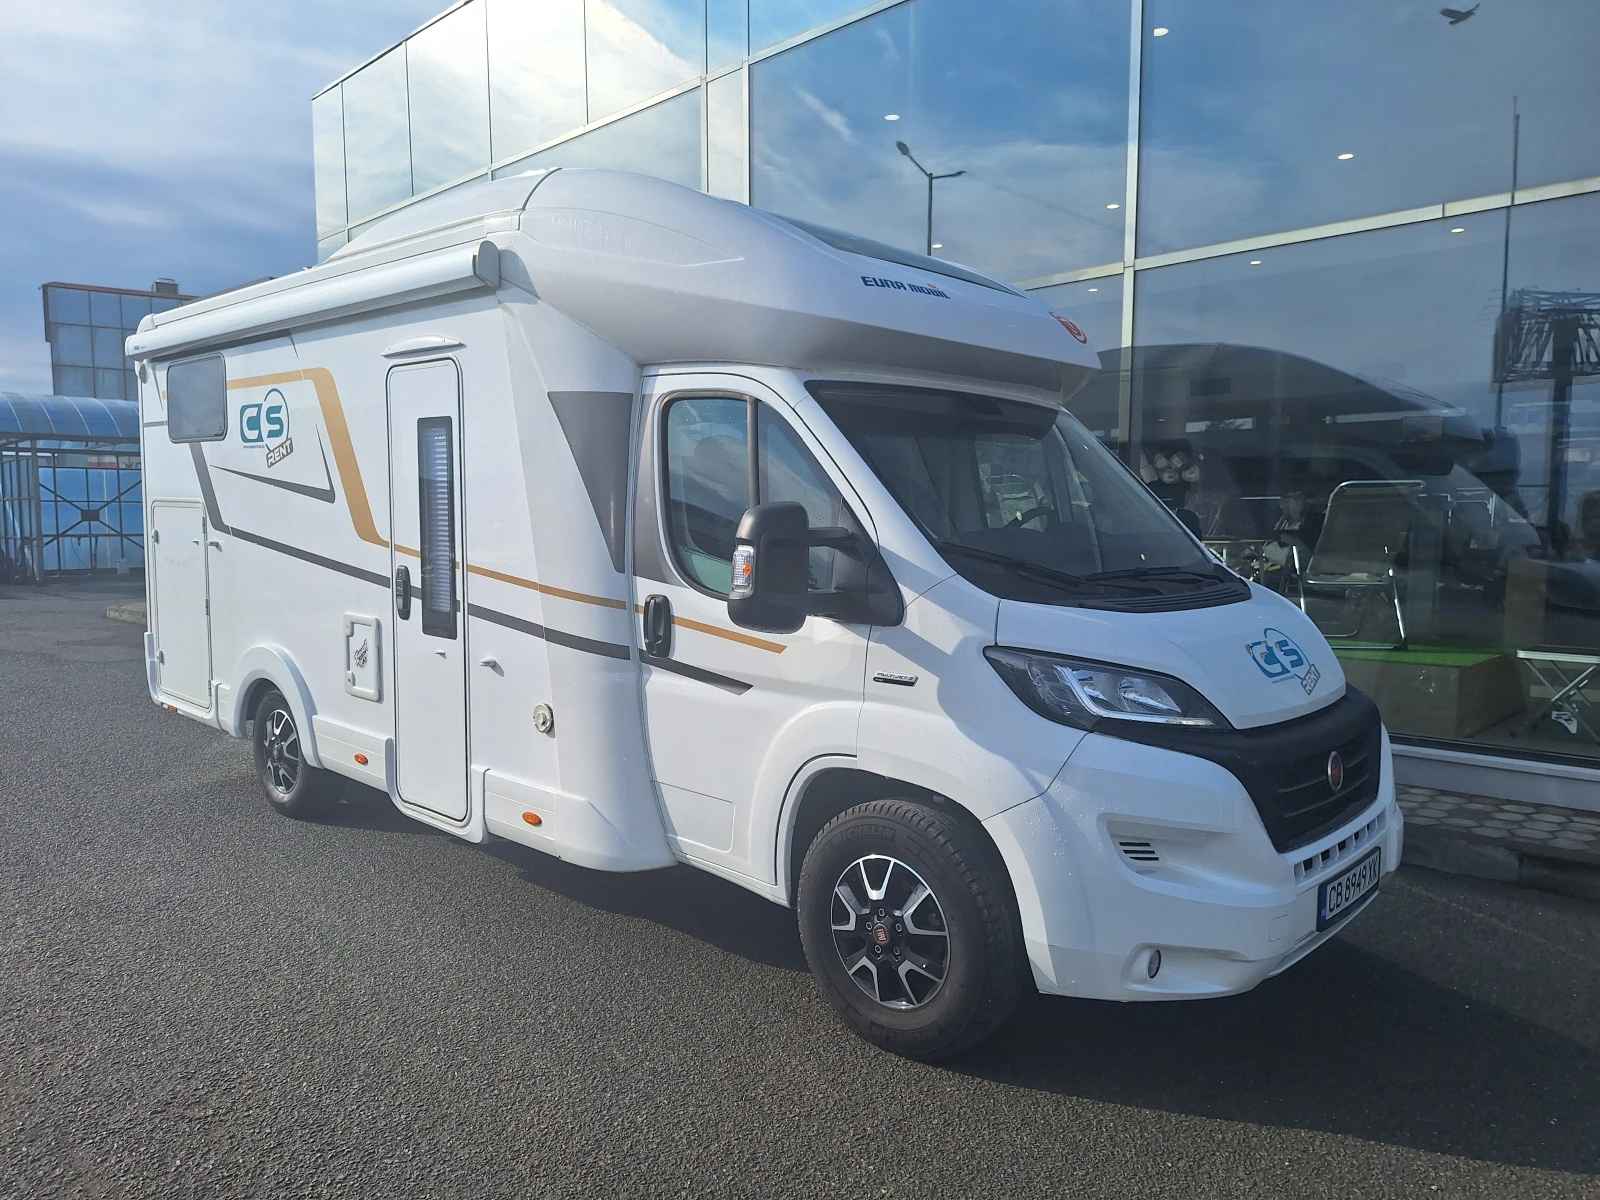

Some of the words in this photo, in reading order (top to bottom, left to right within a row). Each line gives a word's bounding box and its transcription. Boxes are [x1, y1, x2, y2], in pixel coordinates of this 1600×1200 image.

[860, 275, 907, 291] EURA
[267, 439, 294, 466] RENT
[1328, 881, 1343, 913] CB
[1344, 864, 1367, 902] 8949
